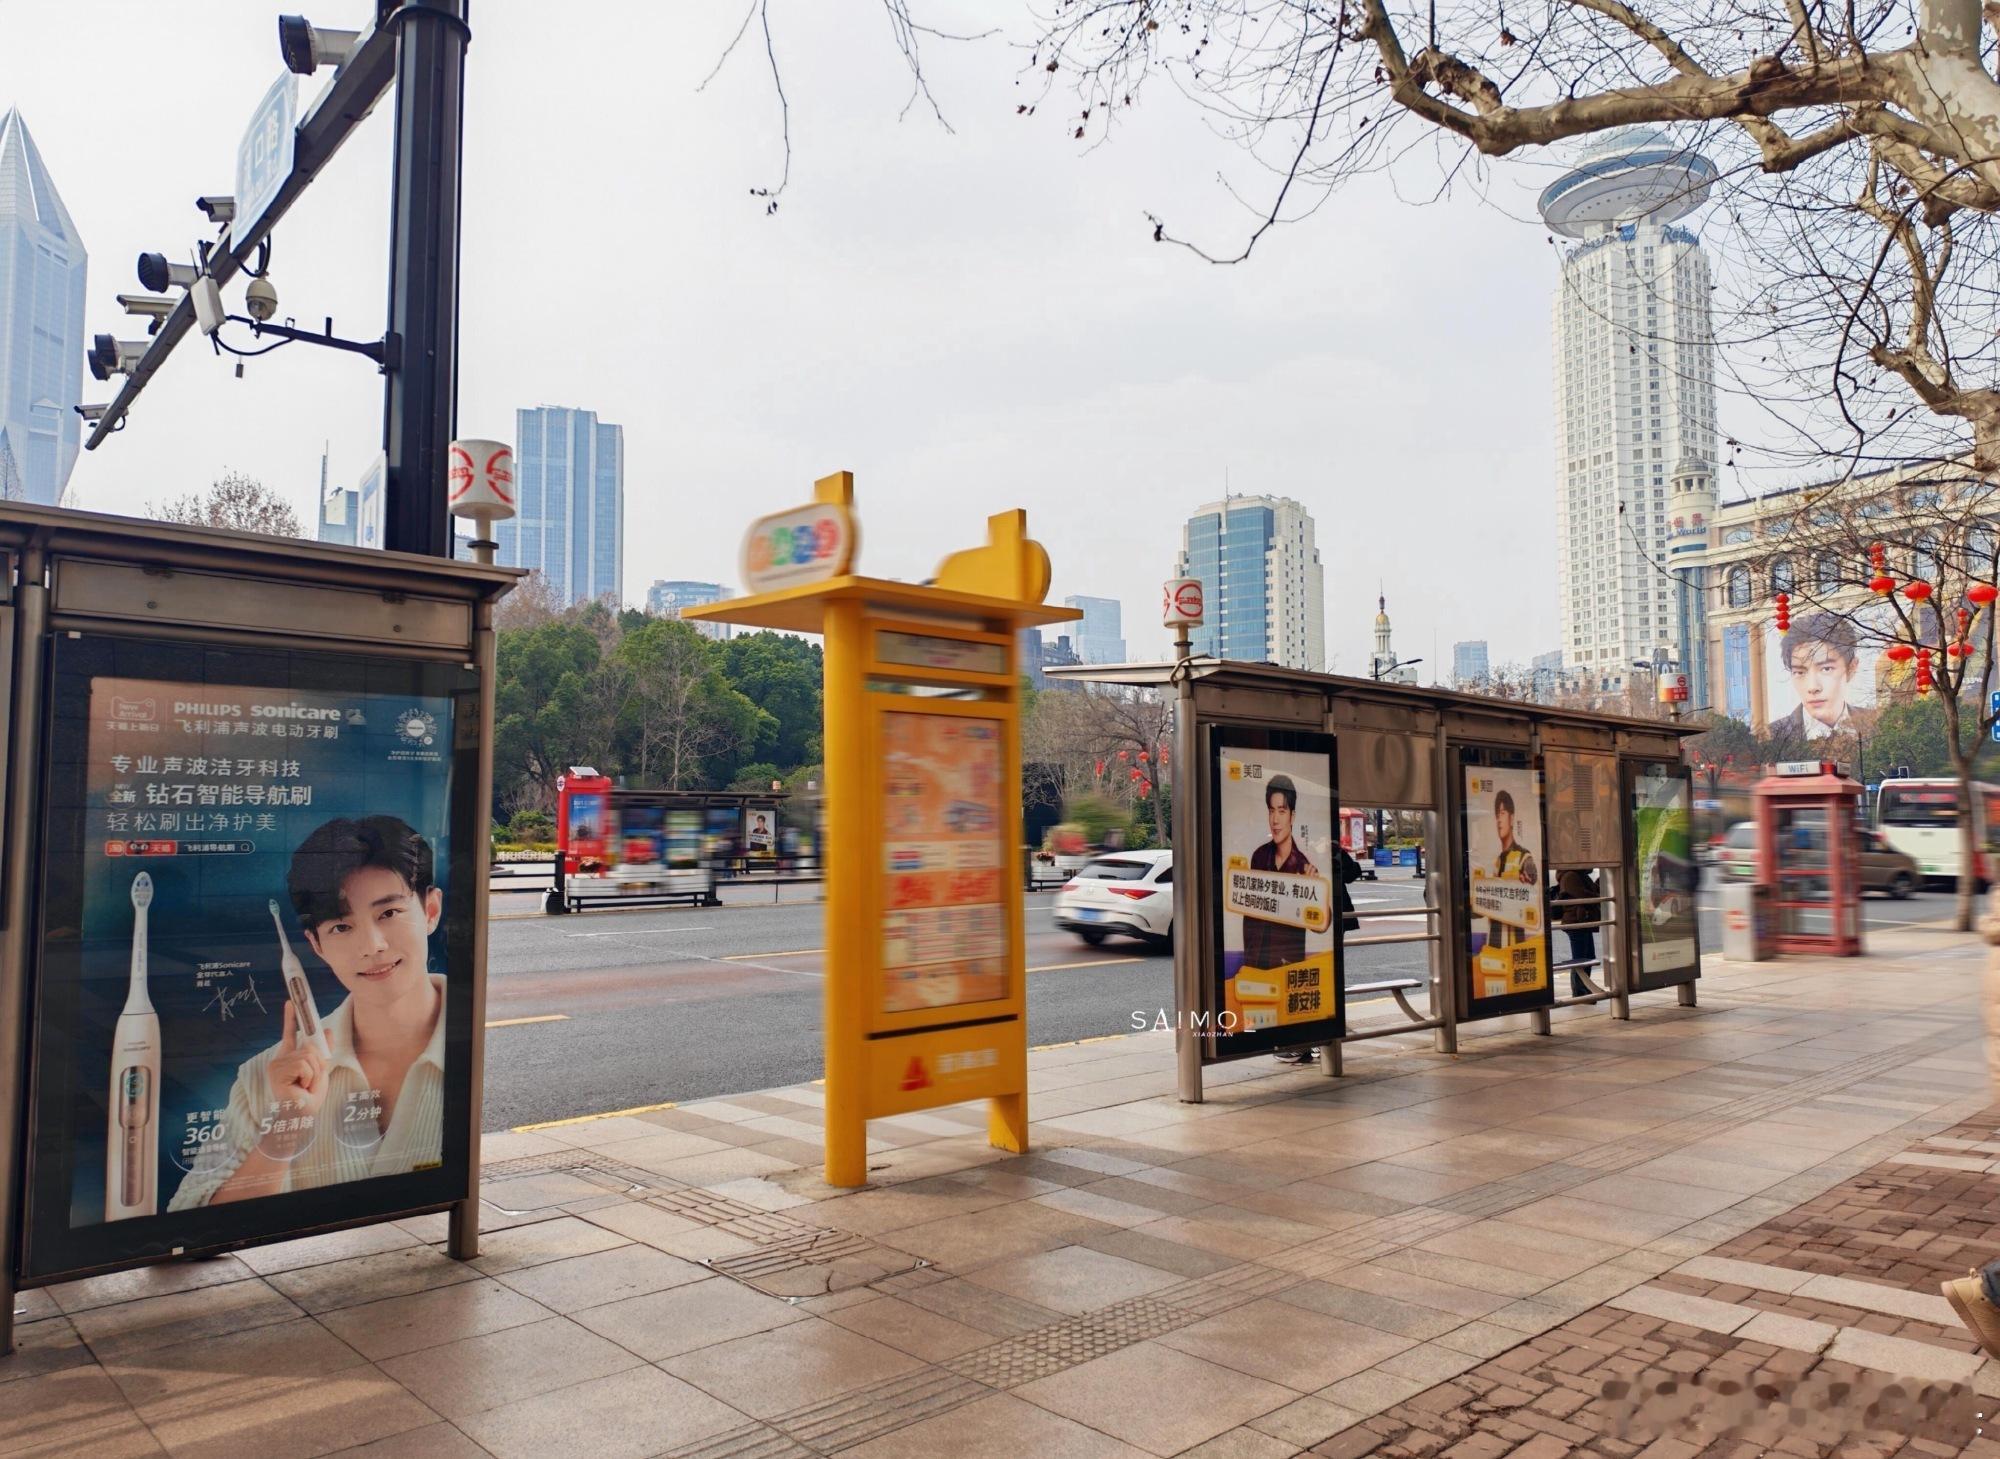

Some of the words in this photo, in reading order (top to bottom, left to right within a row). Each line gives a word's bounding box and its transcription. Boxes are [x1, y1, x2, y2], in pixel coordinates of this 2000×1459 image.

[173, 701, 243, 717] PHILIPS
[250, 702, 342, 721] sonicare
[174, 719, 339, 740] 飞利浦声波电动牙刷
[110, 755, 301, 778] 专业声波洁牙科技
[1243, 764, 1263, 779] 美团
[109, 790, 137, 804] 全新
[145, 782, 313, 806] 钻石智能导航刷
[106, 812, 277, 833] 轻松刷出净护美
[1287, 989, 1322, 1013] 都安排
[343, 1105, 382, 1122] 2分钟
